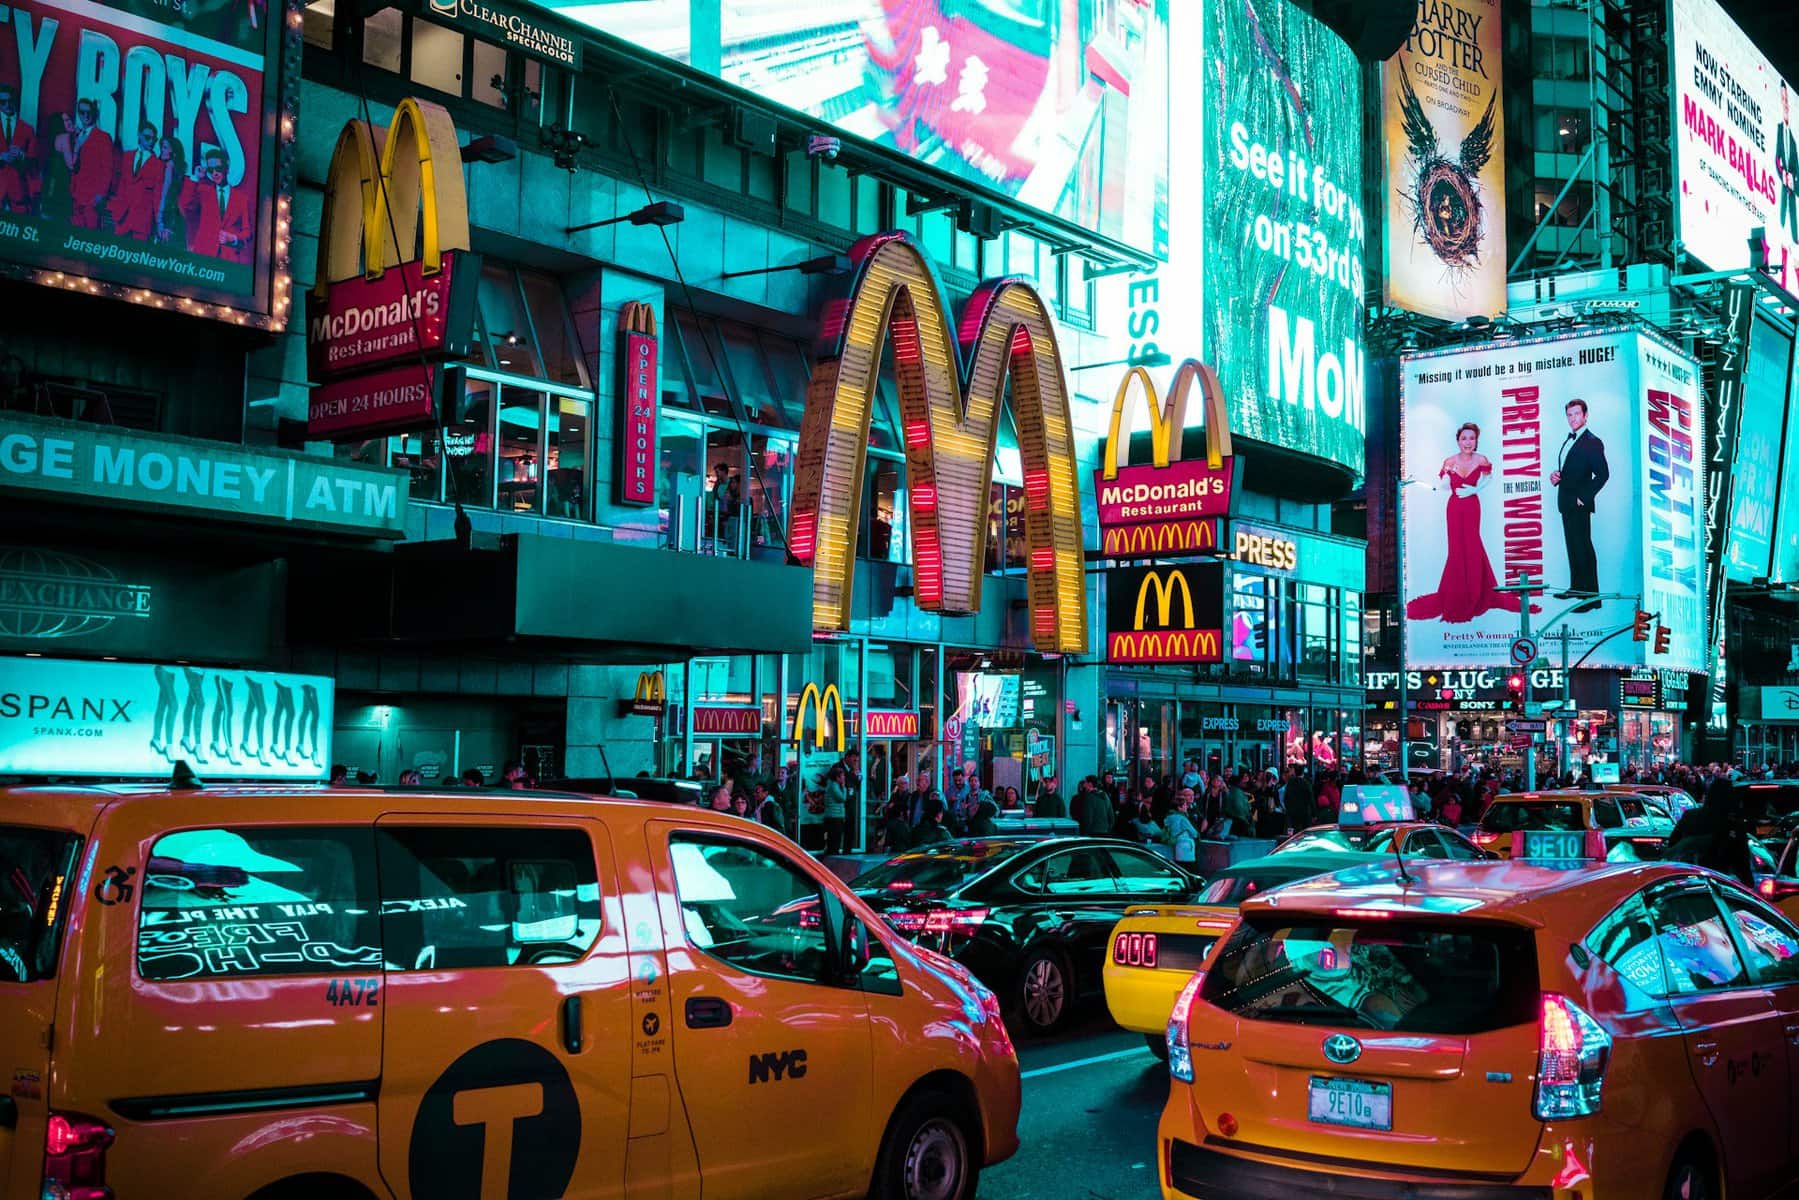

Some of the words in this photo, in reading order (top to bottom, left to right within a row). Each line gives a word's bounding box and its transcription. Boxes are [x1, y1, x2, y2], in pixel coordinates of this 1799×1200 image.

[506, 31, 574, 64] SPECTACOLOR
[1406, 22, 1488, 80] POTTER
[1415, 62, 1451, 86] CURSED
[1452, 77, 1481, 97] CHILD
[1696, 39, 1718, 79] NOW
[1720, 66, 1763, 125] STARRING
[76, 28, 248, 187] BOYS
[1694, 64, 1722, 110] EMMY
[1727, 98, 1766, 154] NOMINEE
[1684, 93, 1726, 160] MARK
[1728, 135, 1776, 205] BALLAS
[1230, 121, 1284, 190] See
[1287, 153, 1308, 200] it
[1311, 170, 1349, 220] for
[64, 235, 226, 283] JerseyBoysNewYork.com
[1256, 214, 1291, 261] on
[1294, 223, 1350, 292] 53rd
[310, 289, 440, 344] McDonald's
[328, 327, 416, 362] Restaurant
[638, 343, 649, 400] OPEN
[1455, 368, 1462, 381] it
[1465, 366, 1492, 380] would
[1495, 364, 1506, 376] be
[1509, 364, 1514, 374] a
[1518, 361, 1532, 374] big
[1535, 356, 1576, 371] mistake.
[310, 397, 348, 421] OPEN
[352, 395, 369, 412] 24
[373, 384, 425, 409] HOURS
[634, 405, 651, 417] 24
[1501, 385, 1541, 478] PRETTY
[636, 423, 648, 494] HOURS
[94, 445, 276, 503] MONEY
[305, 476, 397, 520] ATM
[1102, 477, 1224, 505] McDonald's
[1503, 482, 1514, 494] THE
[1515, 480, 1541, 493] MUSICAL
[1121, 500, 1203, 518] Restaurant
[1231, 532, 1296, 571] PRESS
[1, 581, 151, 612] EXCHANGE
[1, 693, 132, 723] SPANX
[1460, 701, 1495, 710] SONY
[33, 726, 104, 737] SPANX.COM
[1203, 717, 1240, 731] EXPRESS
[1257, 719, 1290, 732] EXPRESS
[1530, 836, 1579, 859] 9E10
[326, 978, 379, 1006] 4A72
[749, 1050, 807, 1084] NYC
